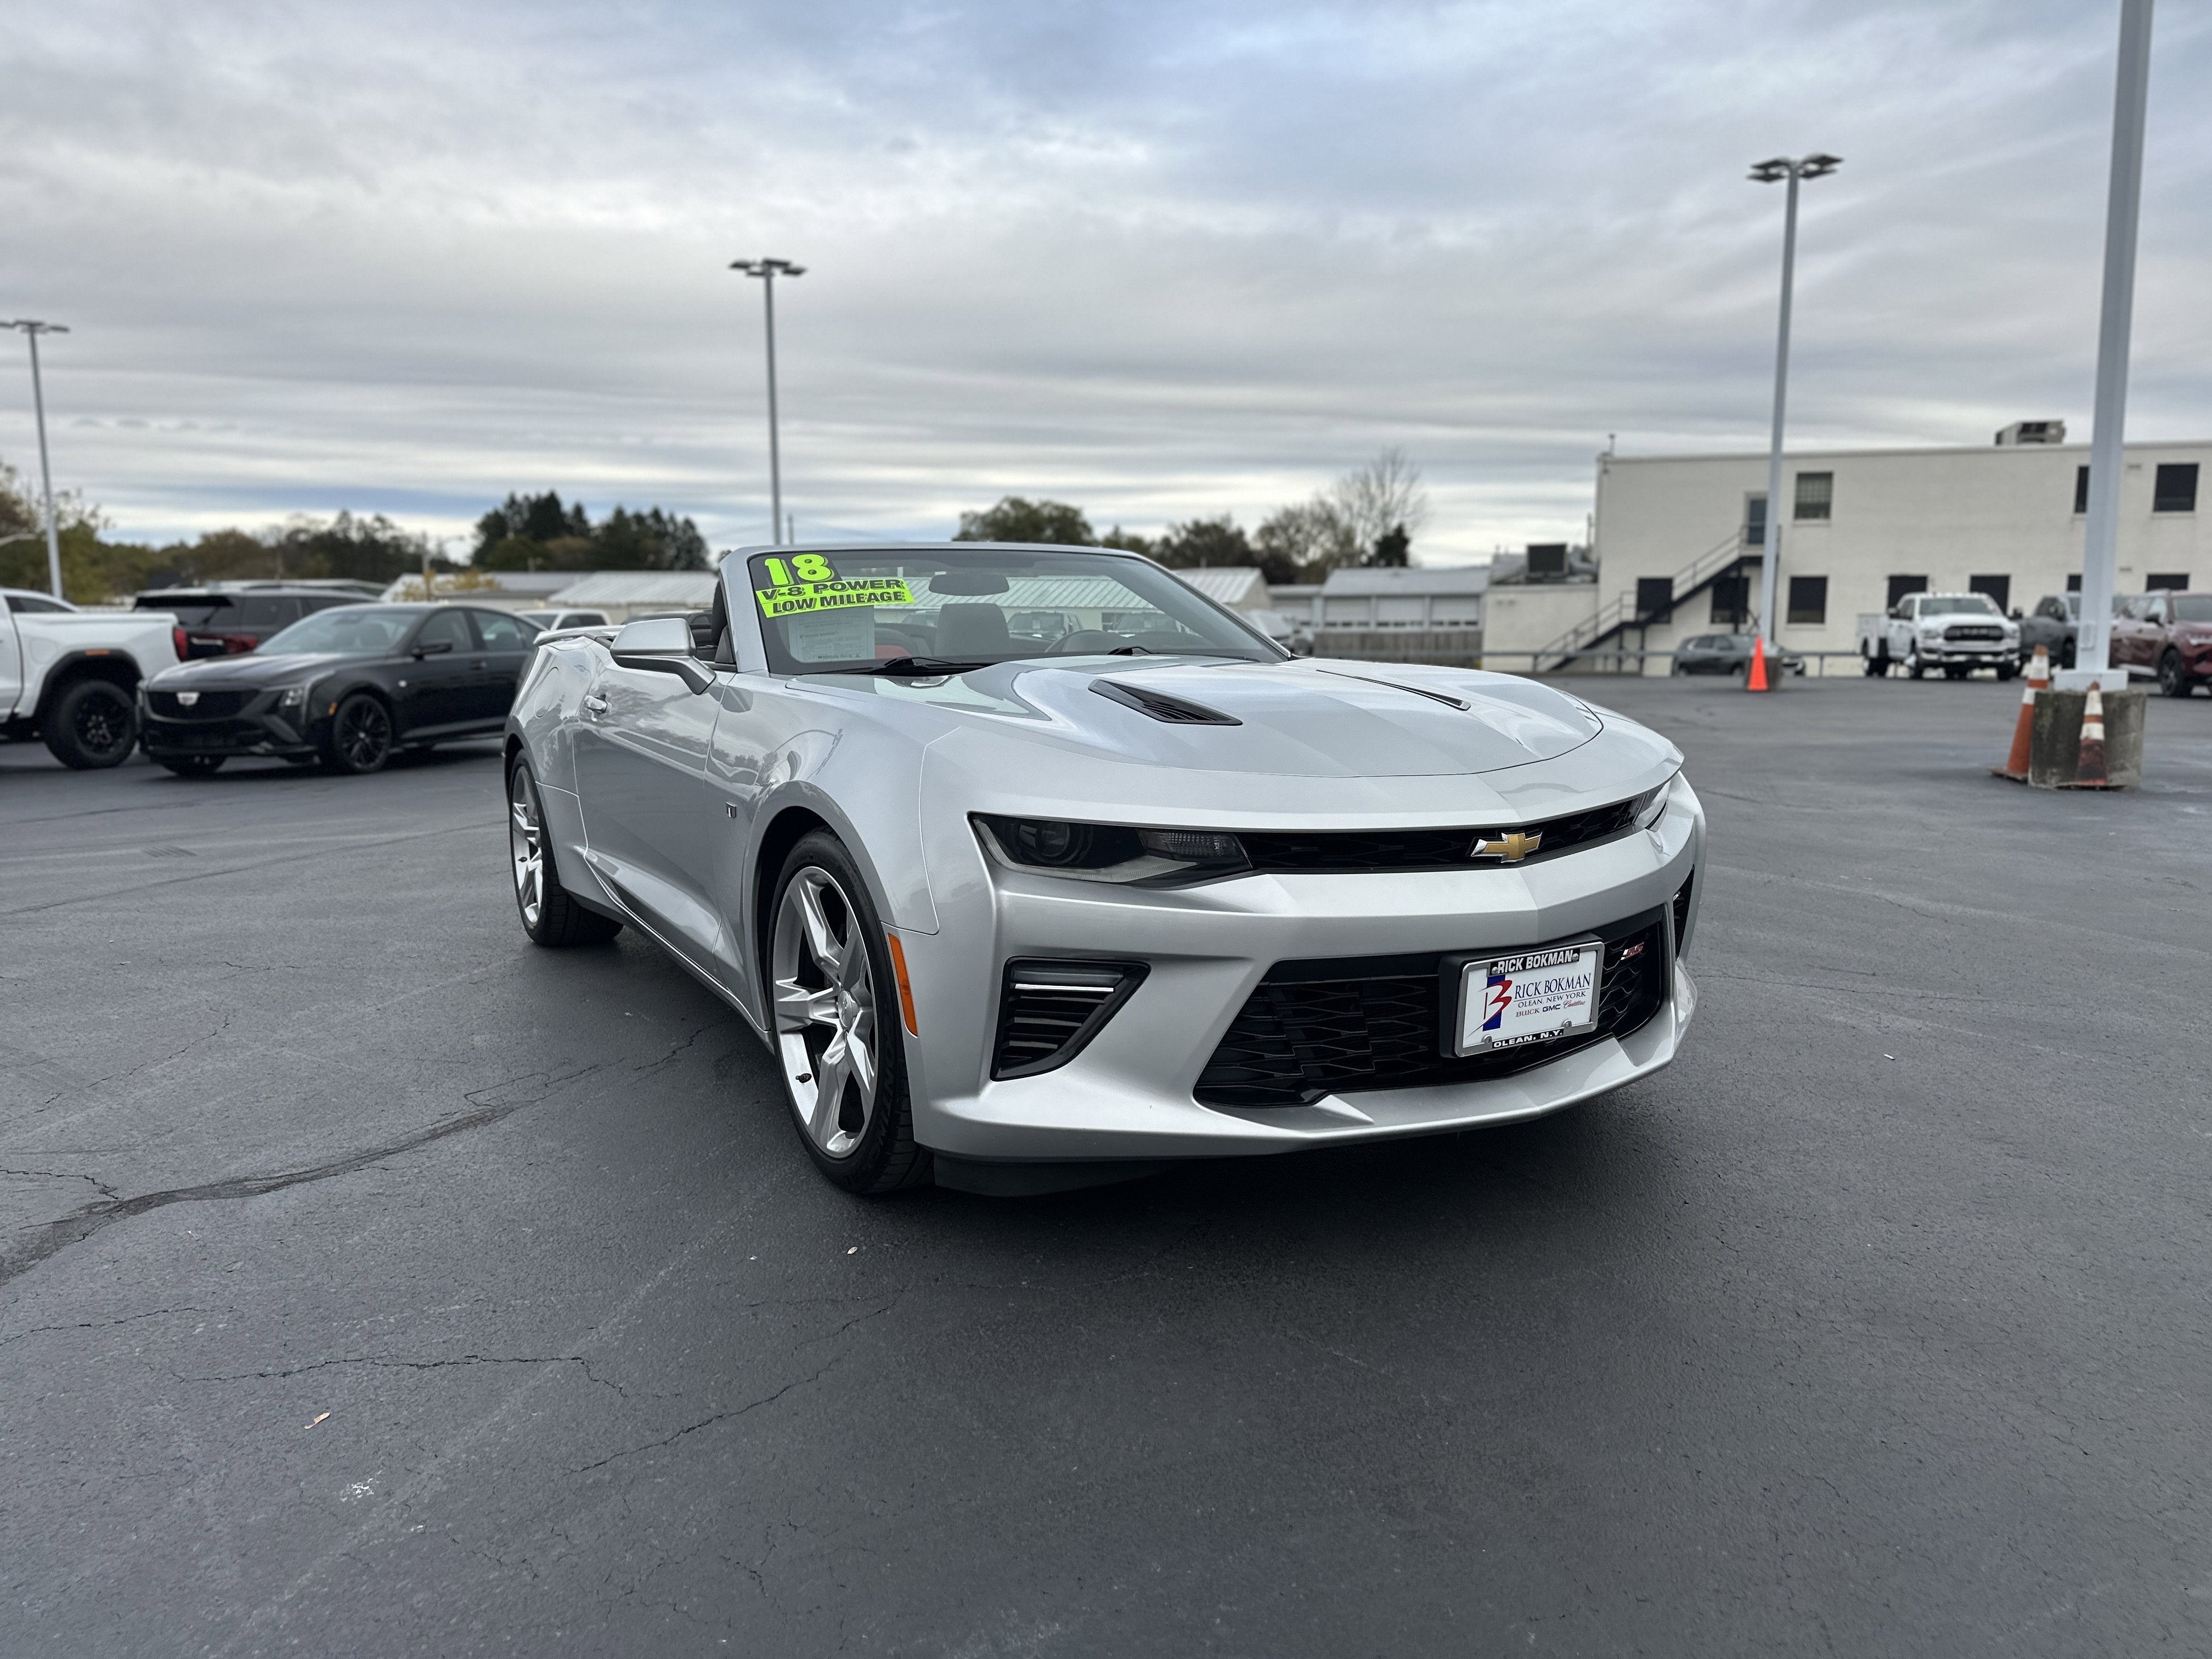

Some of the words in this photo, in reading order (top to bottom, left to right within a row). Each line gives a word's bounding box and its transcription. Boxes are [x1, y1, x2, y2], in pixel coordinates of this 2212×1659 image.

[764, 554, 834, 586] 18
[761, 586, 805, 601] V-8
[813, 579, 905, 594] POWER
[773, 598, 817, 614] LOW
[820, 591, 906, 607] MILEAGE
[1497, 957, 1523, 974] RICK
[1526, 950, 1573, 969] BOKMAN
[1514, 981, 1542, 1000] RICK
[1544, 973, 1592, 994] BOKMAN
[1547, 994, 1565, 1003] NEW
[1565, 990, 1587, 999] YORK
[1516, 1008, 1540, 1017] BUICK
[1542, 1003, 1561, 1012] GMC
[1562, 1000, 1585, 1009] Cadillac
[1540, 1030, 1562, 1039] N.Y.
